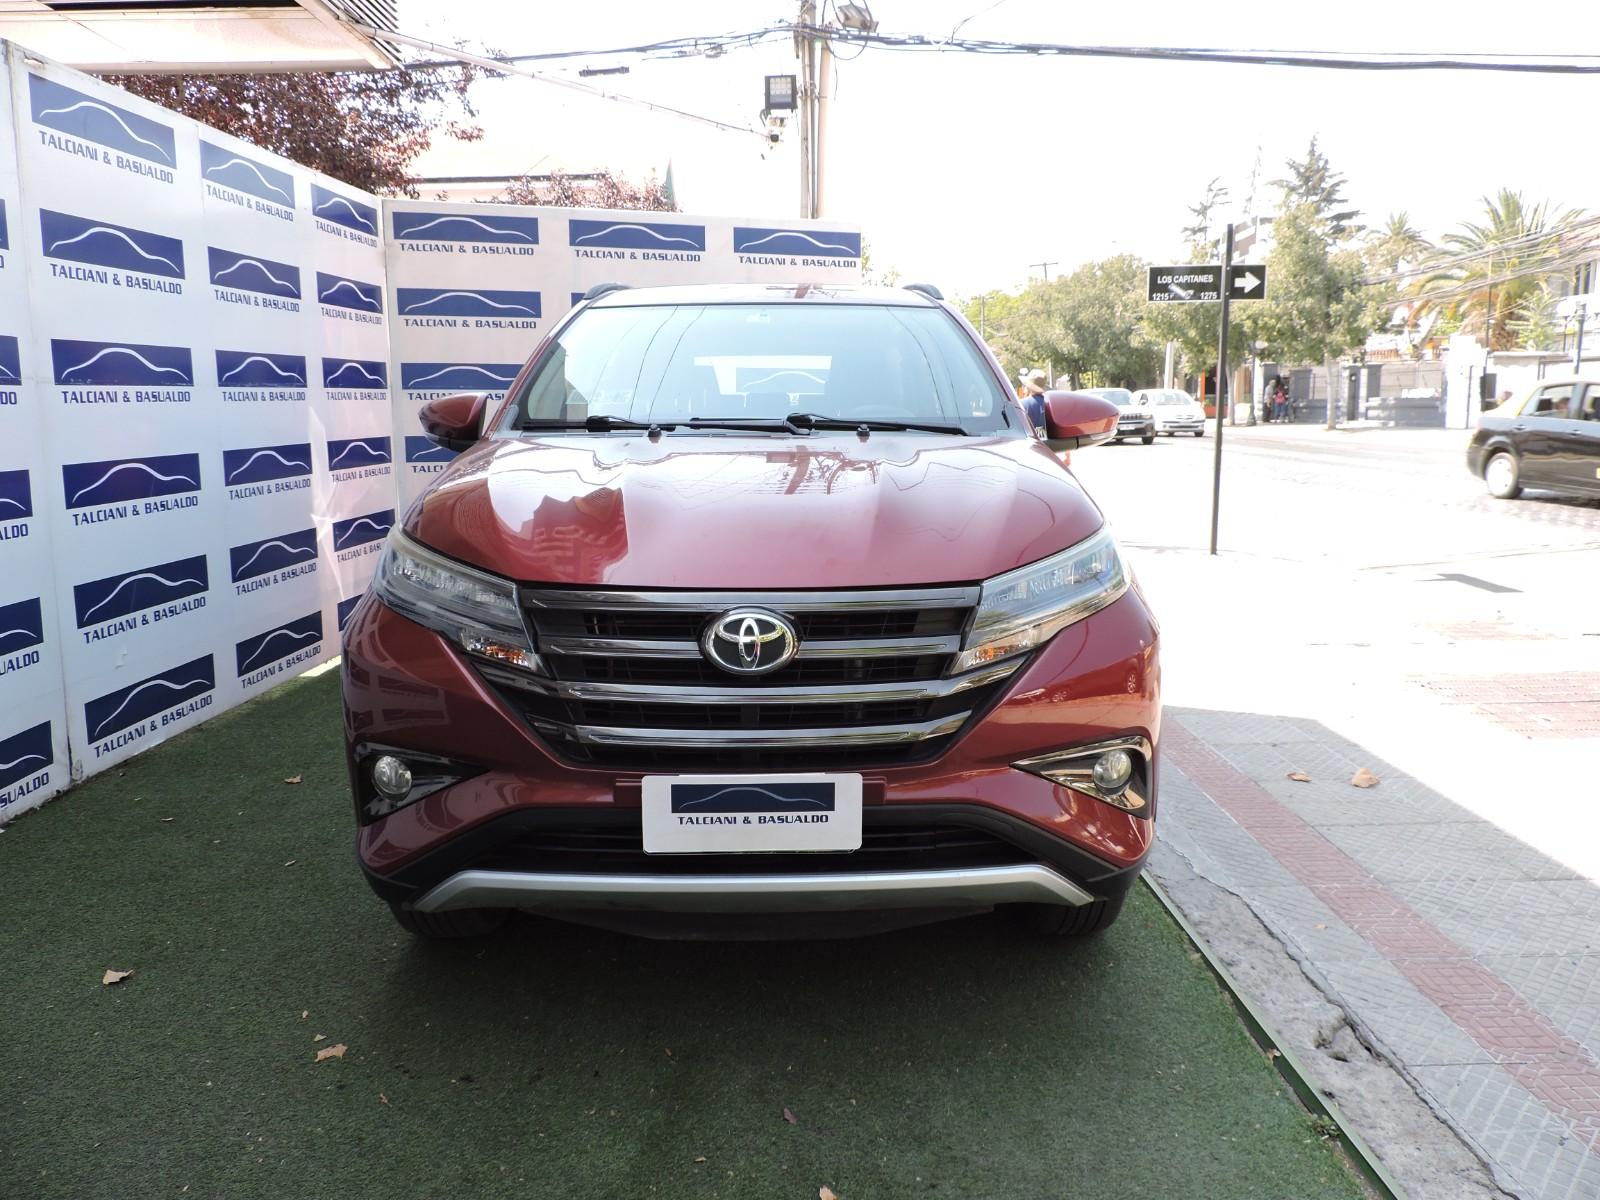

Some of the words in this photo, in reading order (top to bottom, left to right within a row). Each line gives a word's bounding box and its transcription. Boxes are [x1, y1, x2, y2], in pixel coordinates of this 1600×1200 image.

[39, 130, 98, 161] TALCIANI
[103, 152, 111, 164] &
[116, 155, 174, 184] BASUALDO
[207, 184, 243, 207] TALCIANI
[247, 198, 252, 209] &
[256, 200, 294, 222] BASUALDO
[316, 220, 341, 237] TALCIANI
[349, 231, 377, 248] BASUALDO
[400, 243, 453, 253] TALCIANI
[458, 244, 466, 254] &
[472, 245, 534, 256] BASUALDO
[575, 249, 625, 260] TALCIANI
[629, 250, 637, 260] &
[642, 251, 700, 262] BASUALDO
[739, 256, 786, 266] TALCIANI
[789, 257, 798, 267] &
[802, 258, 856, 268] BASUALDO
[50, 263, 107, 285] TALCIANI
[113, 273, 121, 286] &
[126, 275, 182, 295] BASUALDO
[1157, 275, 1172, 284] LOS
[1173, 274, 1214, 283] CAPITANES
[214, 289, 251, 306] TALCIANI
[254, 296, 260, 306] &
[262, 297, 300, 312] BASUALDO
[1152, 292, 1169, 300] 1215
[1200, 291, 1217, 300] 1275
[321, 307, 347, 321] TALCIANI
[354, 312, 382, 325] BASUALDO
[404, 318, 457, 328] TALCIANI
[461, 319, 470, 328] &
[475, 319, 537, 329] BASUALDO
[62, 390, 118, 404] TALCIANI
[122, 391, 131, 403] &
[135, 391, 191, 403] BASUALDO
[222, 391, 260, 402] TALCIANI
[261, 391, 267, 402] &
[269, 391, 306, 402] BASUALDO
[326, 391, 352, 401] TALCIANI
[359, 391, 387, 401] BASUALDO
[332, 470, 357, 482] TALCIANI
[365, 466, 391, 477] BASUALDO
[229, 486, 264, 501] TALCIANI
[266, 485, 272, 495] &
[274, 478, 311, 493] BASUALDO
[73, 506, 127, 526] TALCIANI
[132, 504, 140, 517] &
[145, 495, 198, 514] BASUALDO
[337, 548, 361, 563] TALCIANI
[236, 576, 270, 596] TALCIANI
[273, 574, 279, 584] &
[281, 562, 317, 581] BASUALDO
[83, 617, 137, 644] TALCIANI
[142, 614, 150, 626] &
[154, 596, 206, 622] BASUALDO
[242, 669, 275, 688] TALCIANI
[278, 662, 284, 672] &
[286, 645, 321, 667] BASUALDO
[94, 726, 146, 759] TALCIANI
[150, 720, 157, 732] &
[161, 694, 212, 728] BASUALDO
[677, 816, 736, 825] TALCIANI
[743, 815, 751, 824] &
[758, 815, 829, 824] BASUALDO
